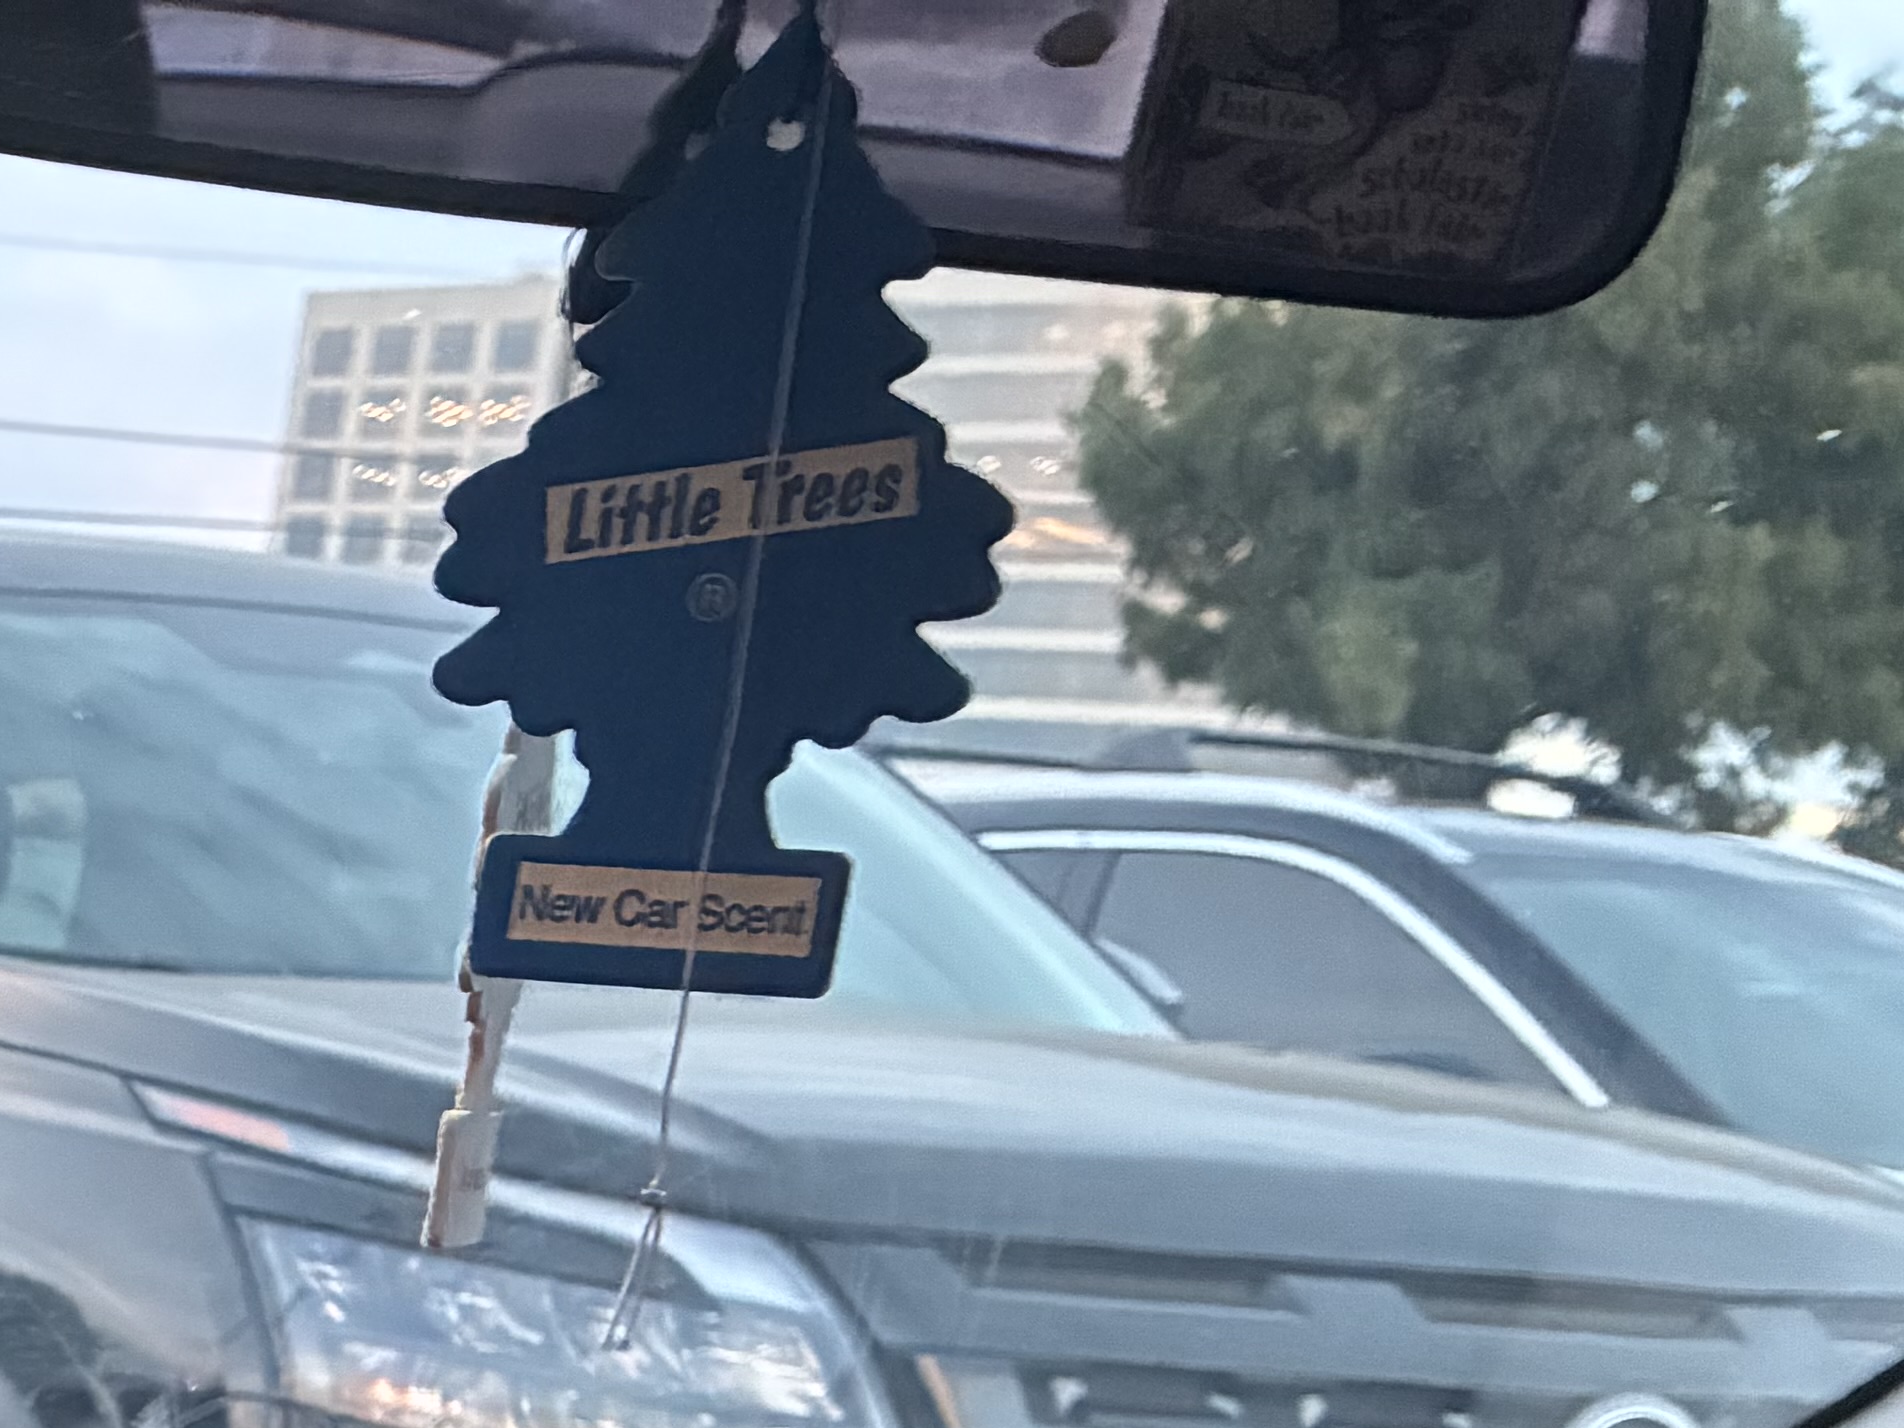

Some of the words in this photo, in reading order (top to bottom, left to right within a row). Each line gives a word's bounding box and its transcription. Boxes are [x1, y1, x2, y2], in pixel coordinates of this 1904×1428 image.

[563, 472, 723, 554] Little
[742, 459, 903, 530] Trees
[518, 882, 607, 926] New
[613, 888, 690, 930] Car
[696, 893, 809, 938] Scent
